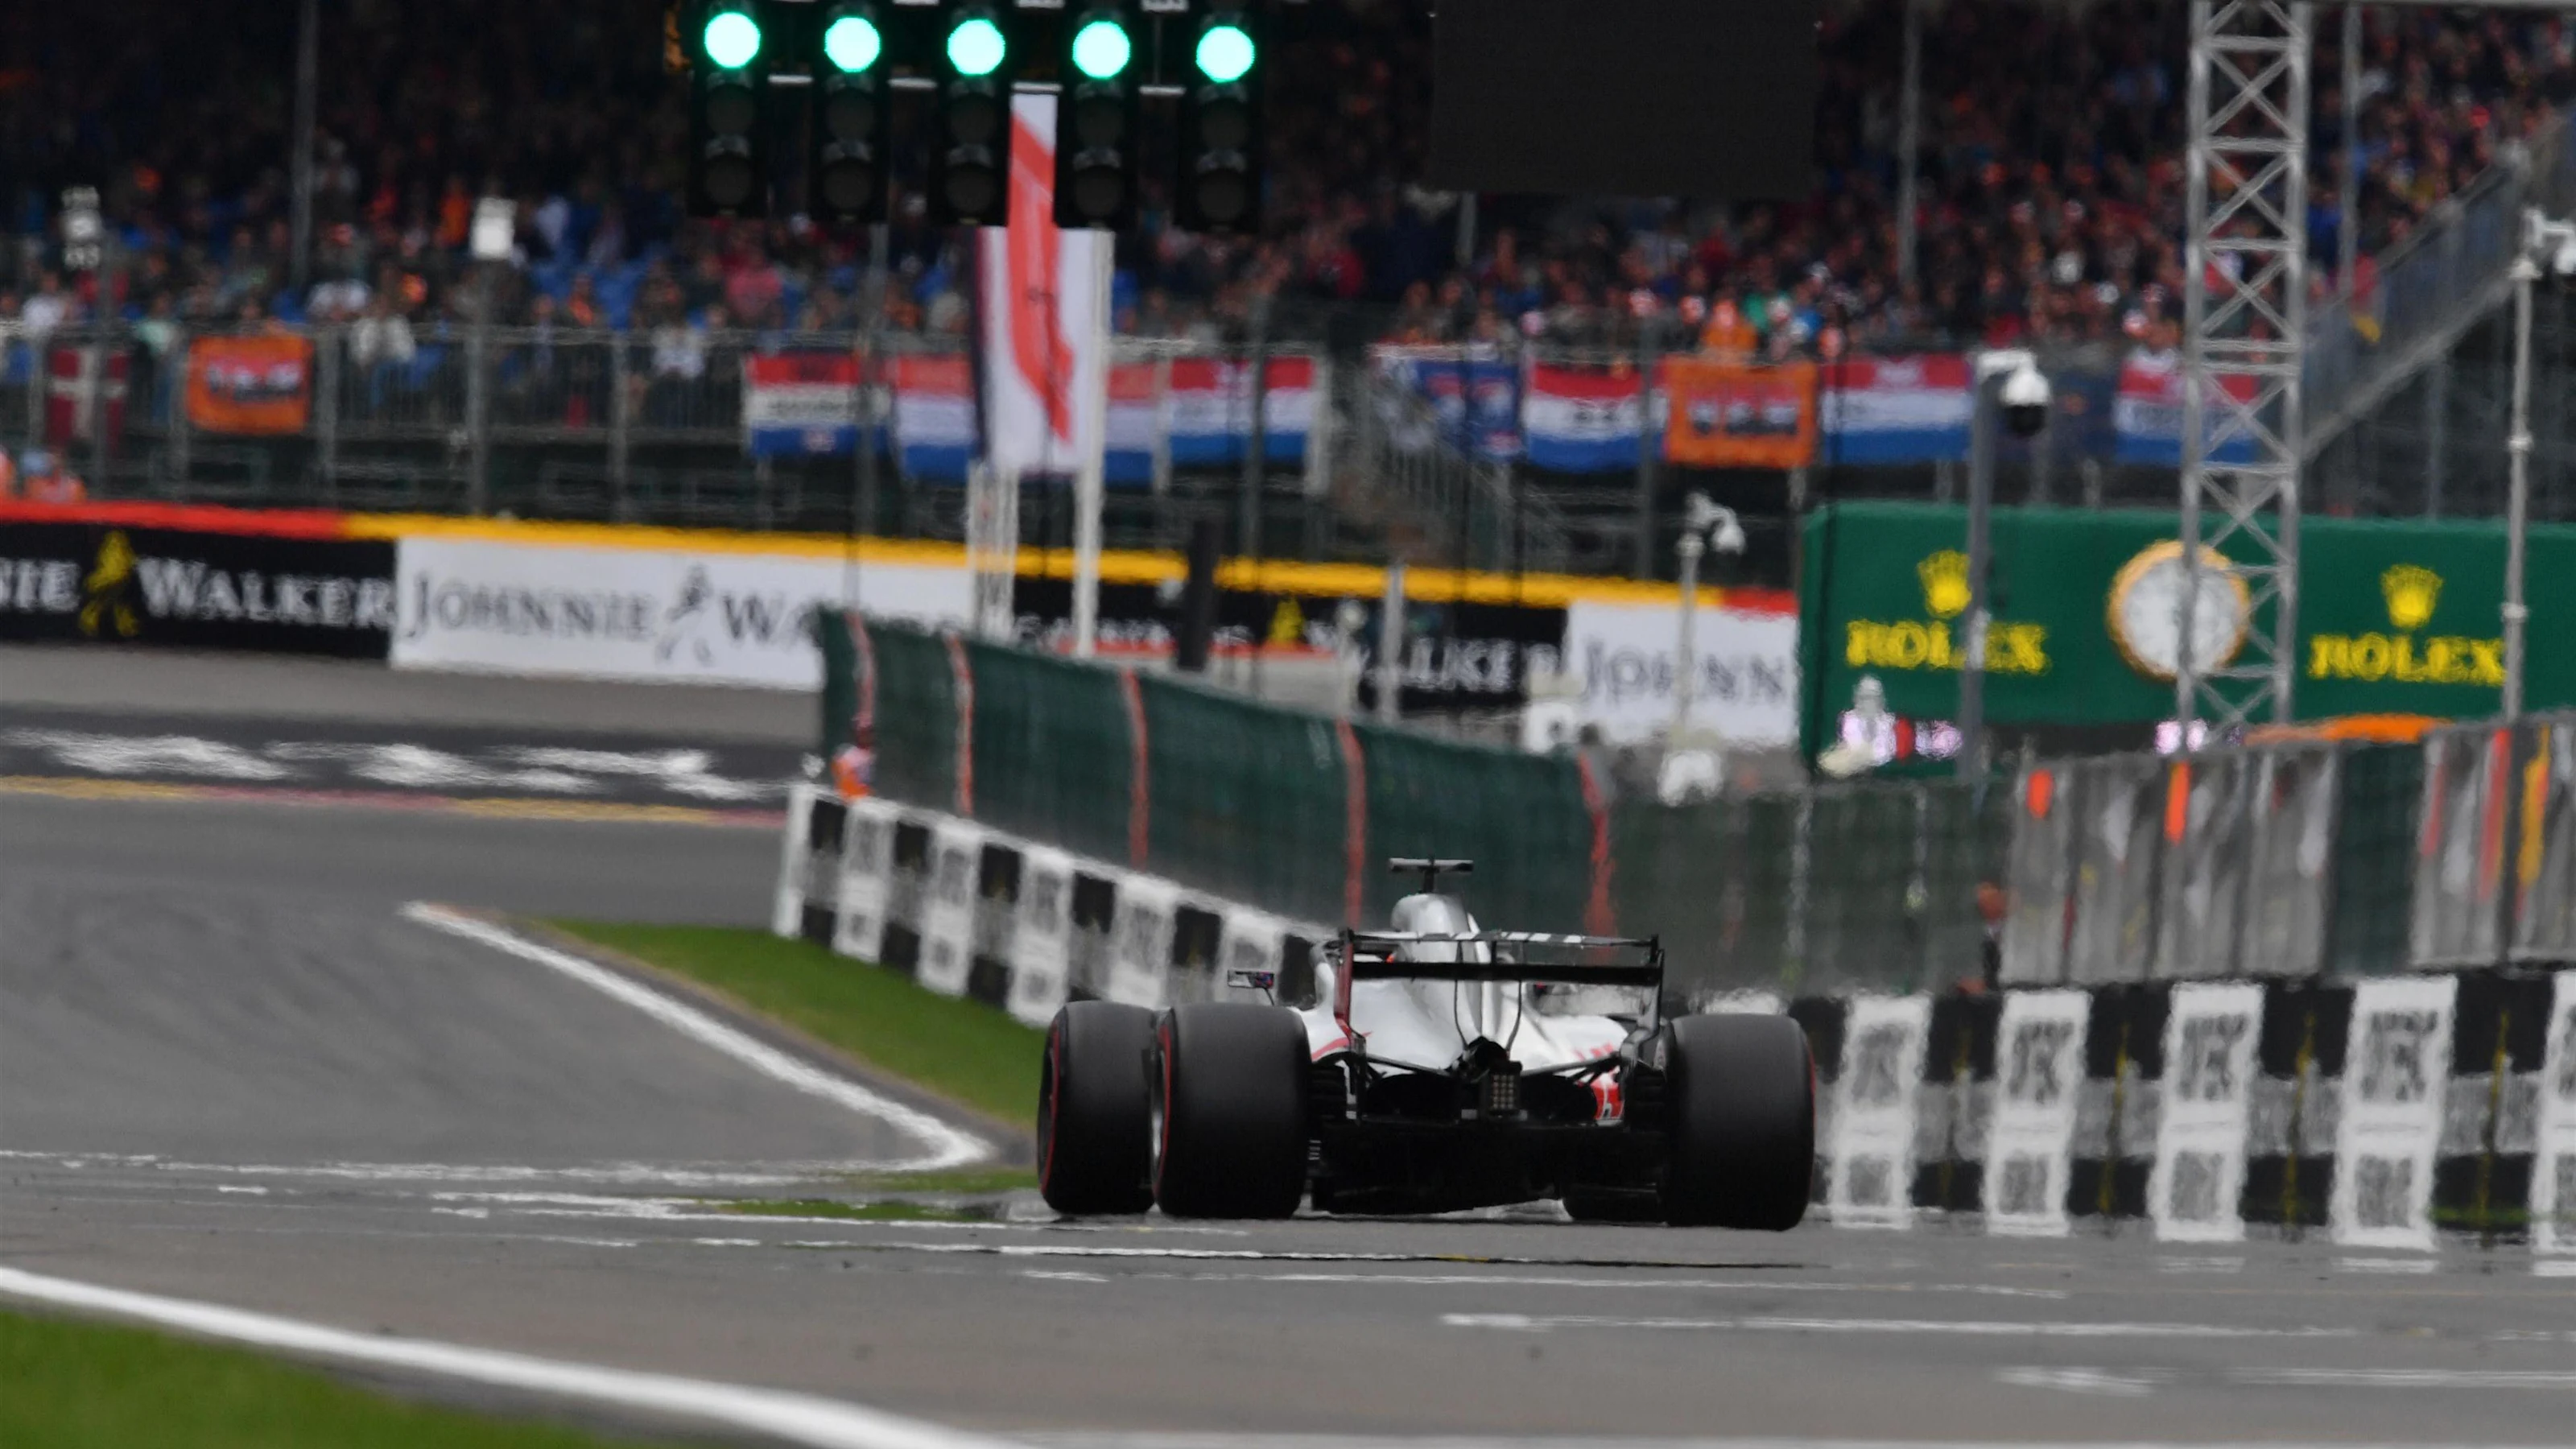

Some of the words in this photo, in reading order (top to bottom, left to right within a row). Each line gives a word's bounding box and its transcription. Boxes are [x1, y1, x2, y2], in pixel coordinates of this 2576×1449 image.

[136, 556, 394, 629] WALKER
[404, 573, 655, 642] JOHNNIE
[1847, 619, 2050, 674] ROLEX
[2309, 633, 2504, 687] ROLEX
